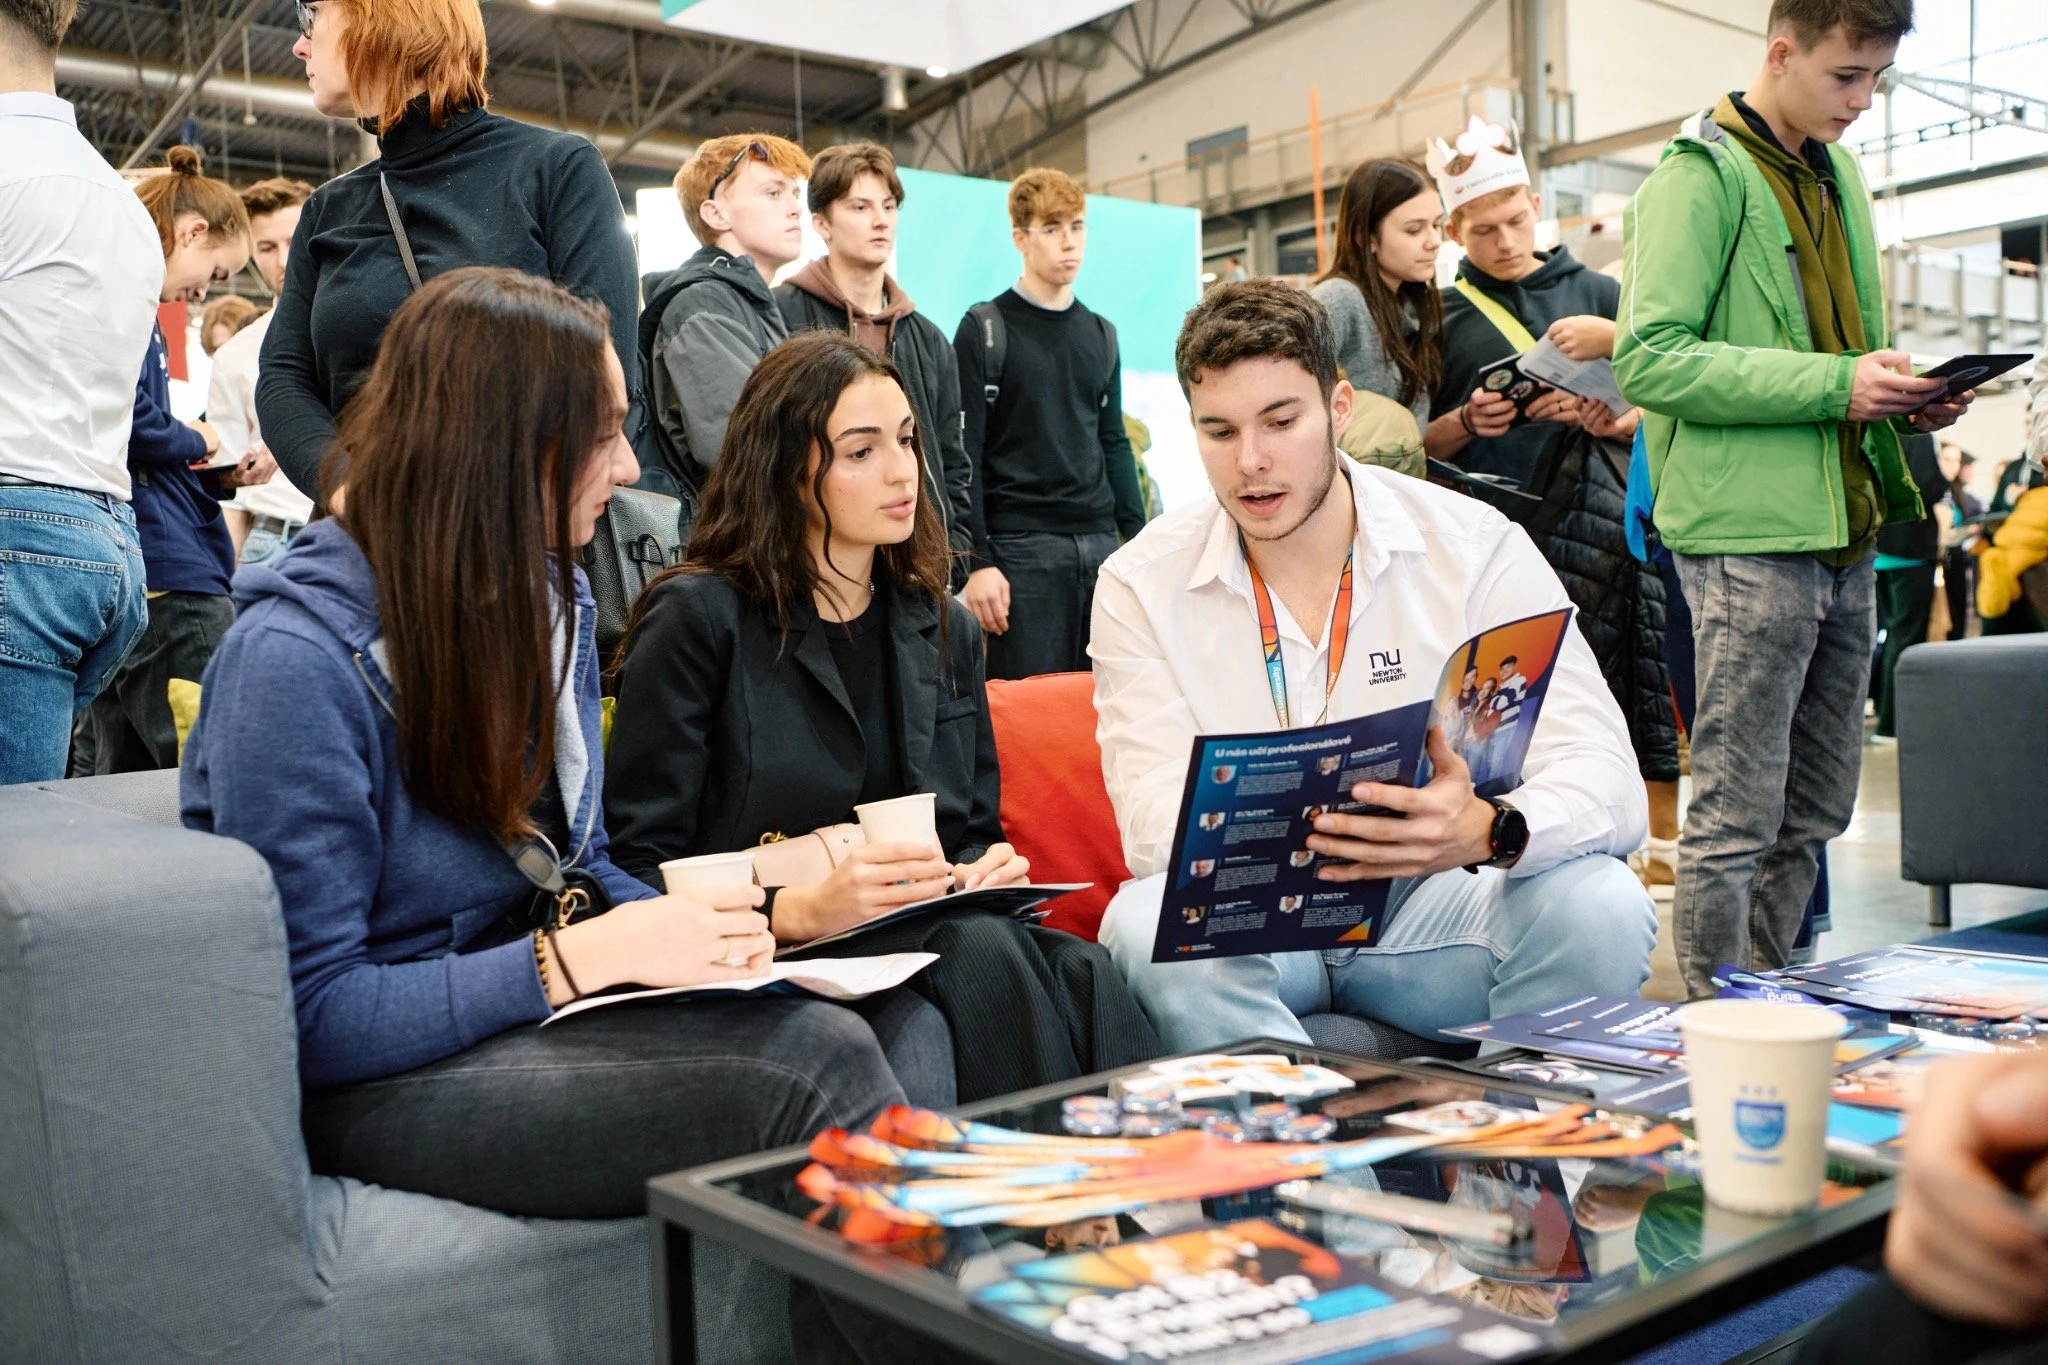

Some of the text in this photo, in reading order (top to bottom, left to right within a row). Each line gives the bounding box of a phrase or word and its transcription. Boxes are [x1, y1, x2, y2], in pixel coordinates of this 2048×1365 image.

[1368, 672, 1406, 685] UNIVERSITY
[1372, 667, 1402, 678] NEWTON
[1272, 666, 1284, 709] University
[1214, 748, 1226, 758] U
[1225, 747, 1247, 757] nás
[1248, 745, 1268, 756] učí
[1266, 734, 1352, 757] profesionálové
